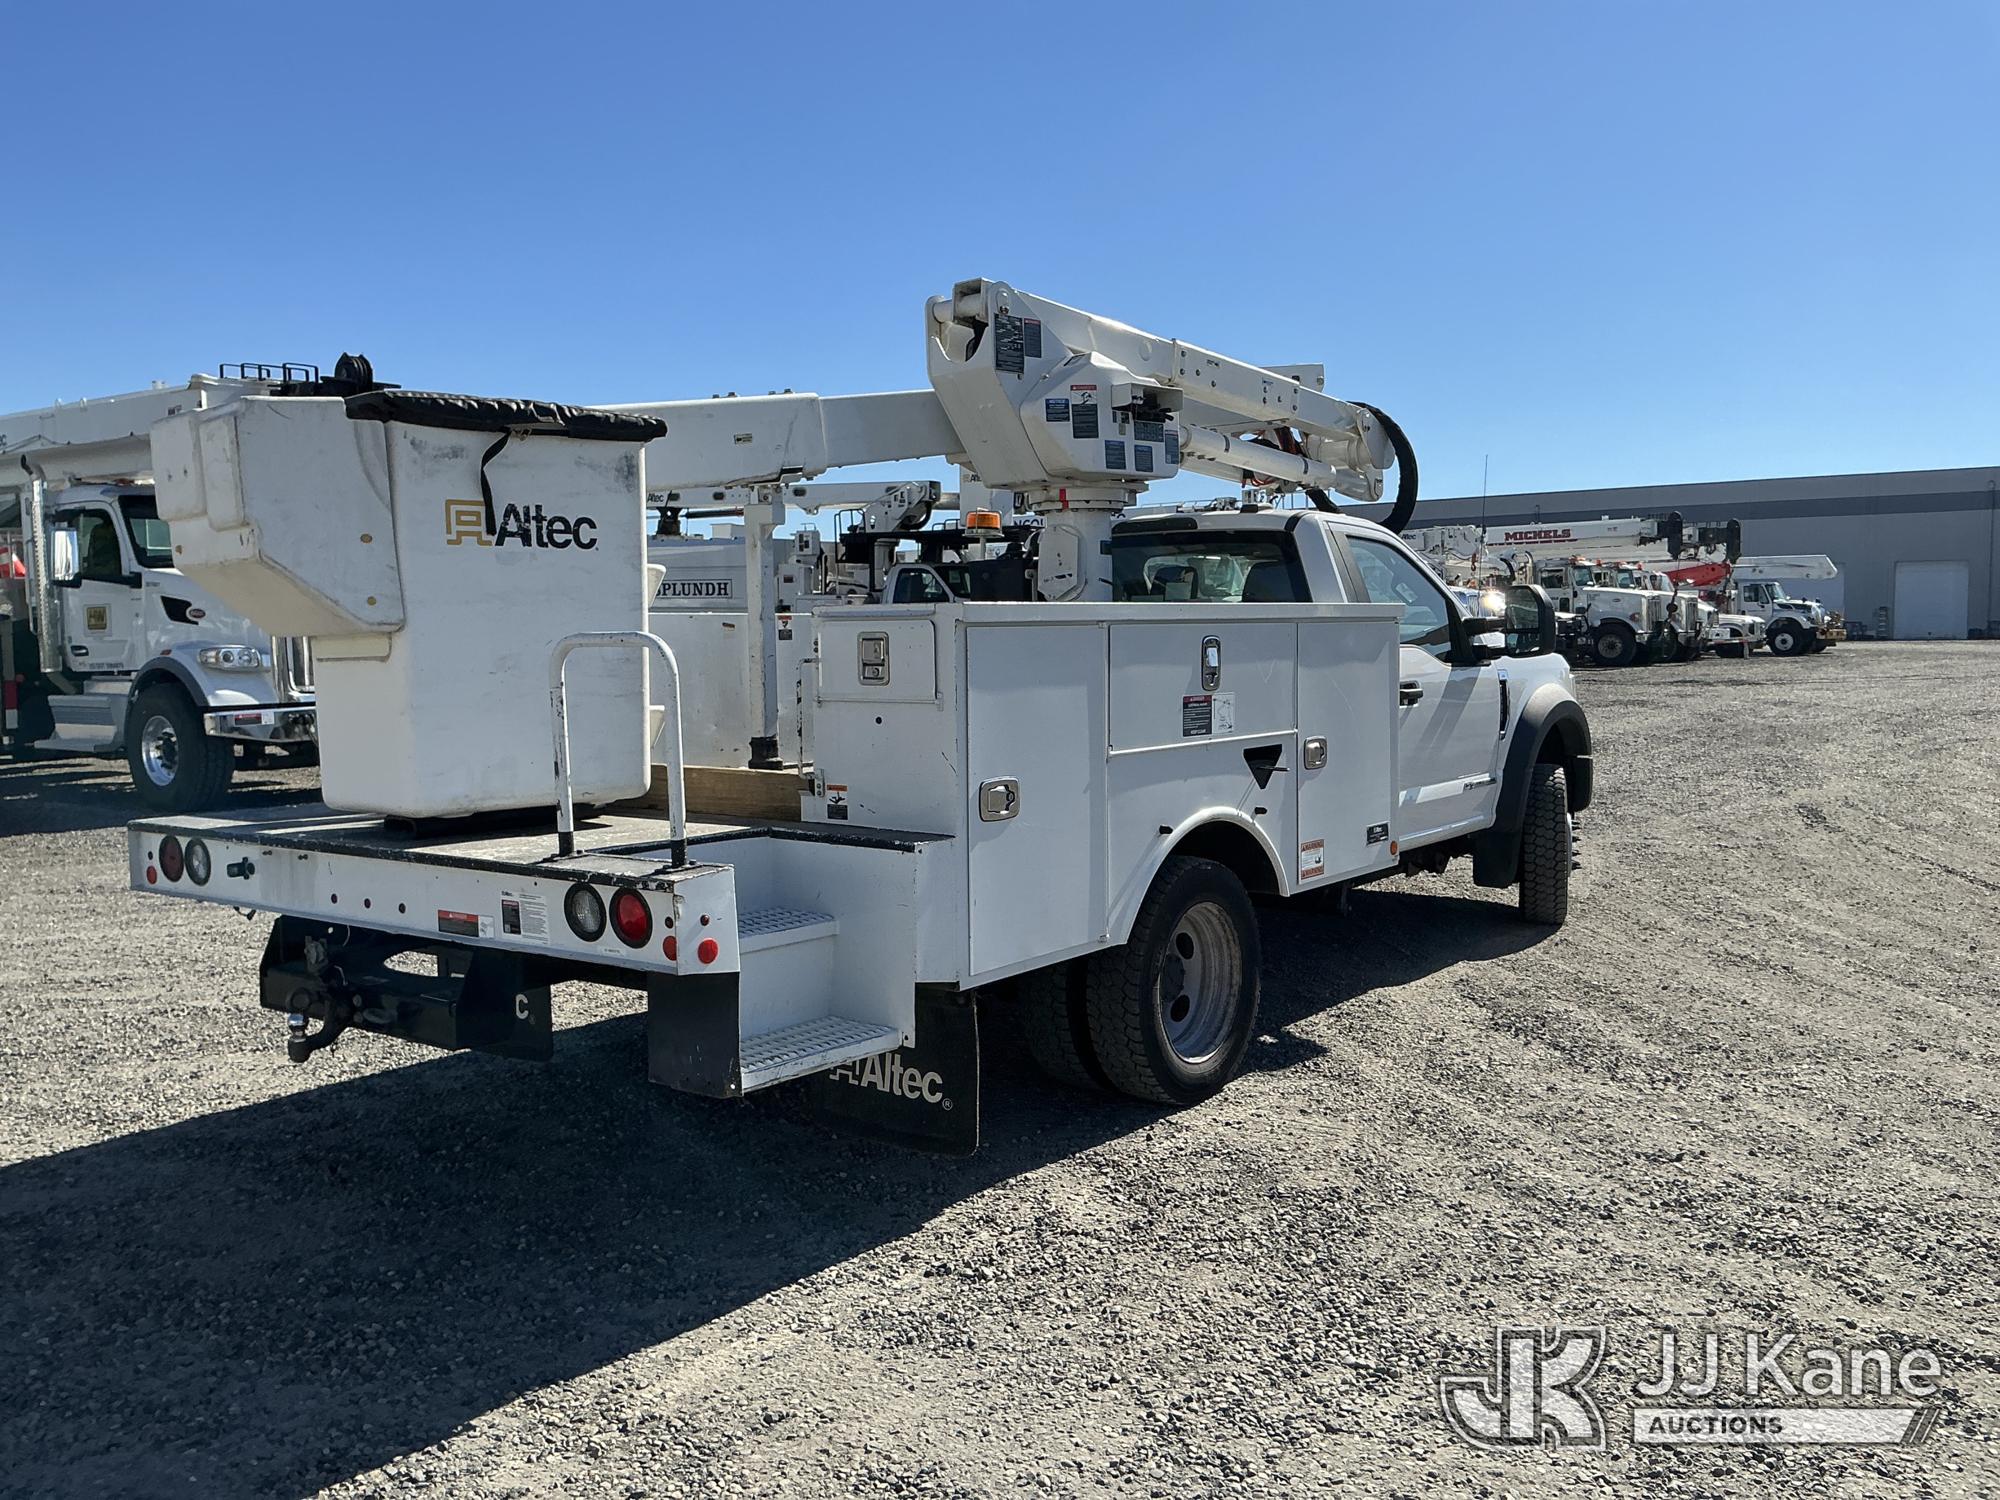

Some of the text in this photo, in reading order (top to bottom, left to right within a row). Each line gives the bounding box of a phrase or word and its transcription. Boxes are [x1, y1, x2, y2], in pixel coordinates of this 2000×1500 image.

[495, 503, 598, 550] Altec
[1505, 528, 1571, 541] MICHELS
[861, 1052, 943, 1103] Altec
